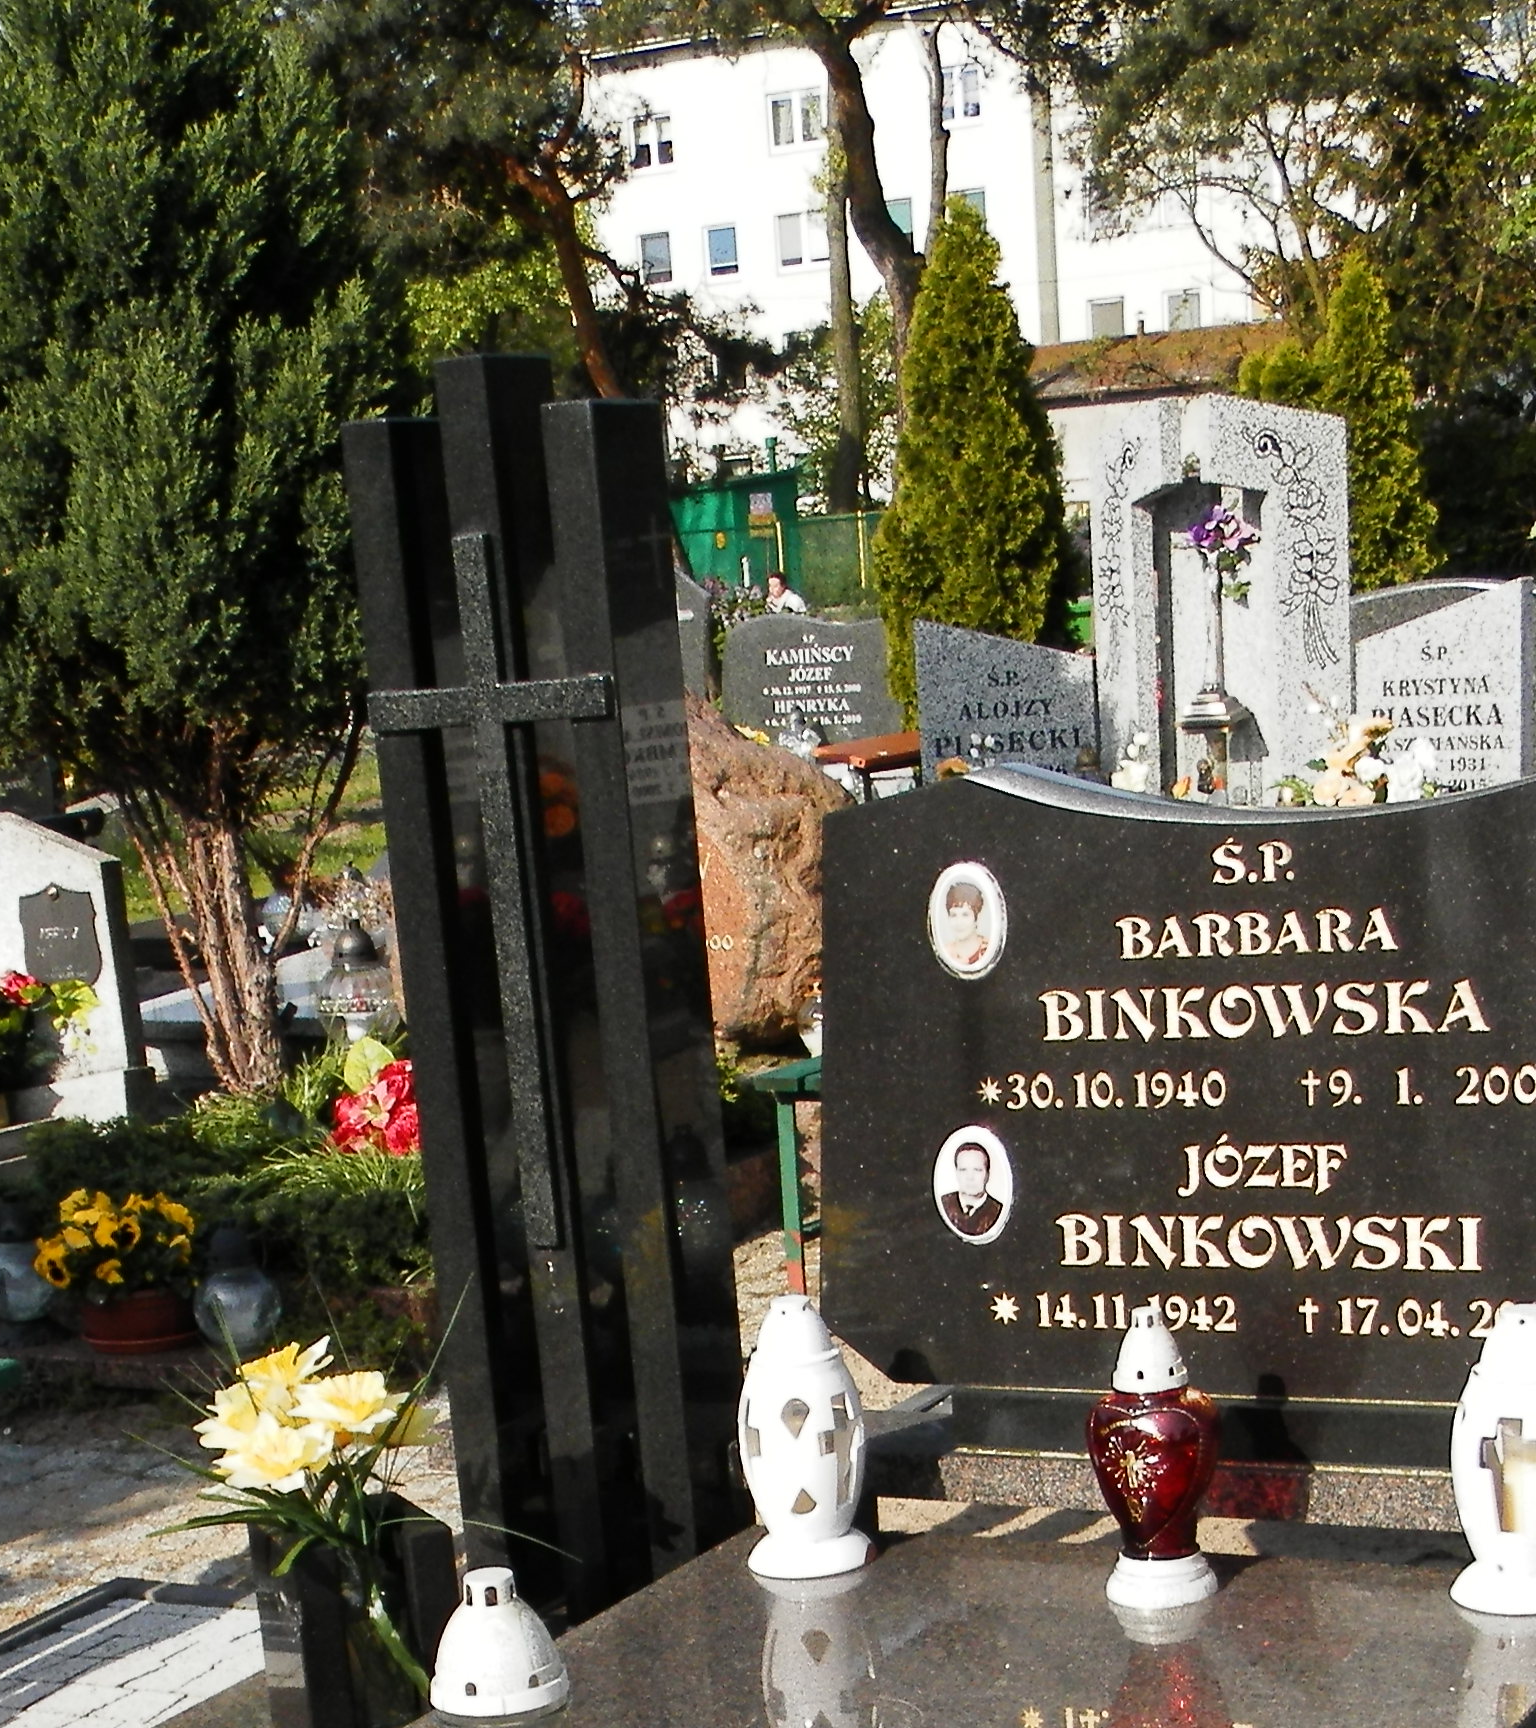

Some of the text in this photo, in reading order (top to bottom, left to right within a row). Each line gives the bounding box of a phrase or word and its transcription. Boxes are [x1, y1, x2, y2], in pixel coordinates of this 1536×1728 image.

[765, 643, 854, 666] KAMIŃSCY
[788, 665, 833, 682] JÓZEF
[1382, 674, 1490, 697] KRYSTYNA
[773, 698, 851, 714] HENRYKA
[959, 698, 1053, 721] ALOJZY
[935, 726, 1082, 758] PISECKI
[1212, 838, 1295, 884] Ś.P.
[1115, 908, 1398, 959] BARBARA
[1039, 979, 1490, 1042] BINKOWSKA
[1178, 1133, 1347, 1197] JÓZEF
[1055, 1214, 1482, 1271] BINKOWSKI
